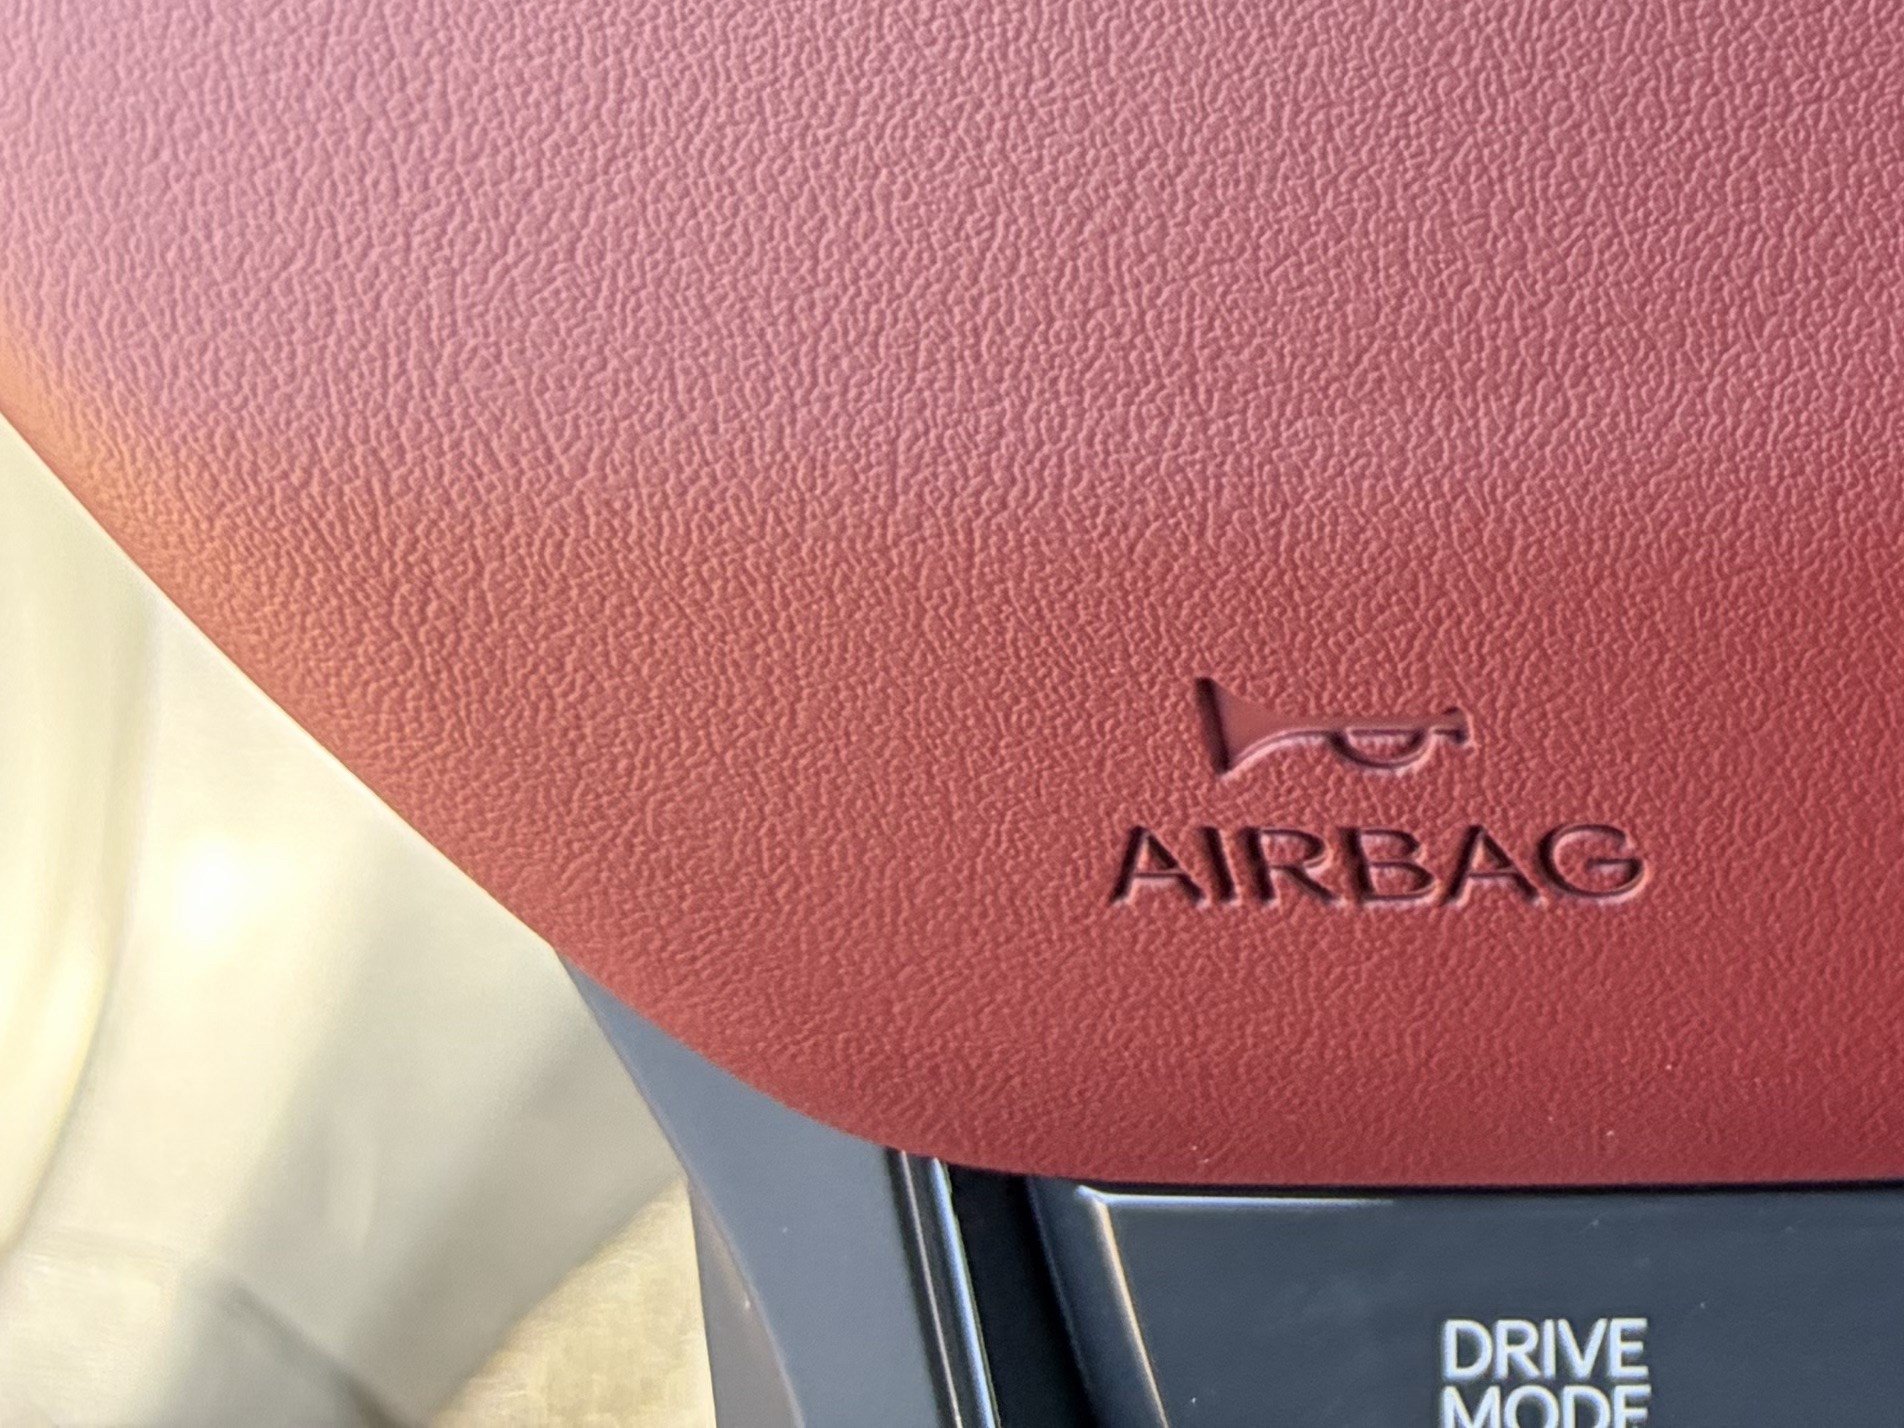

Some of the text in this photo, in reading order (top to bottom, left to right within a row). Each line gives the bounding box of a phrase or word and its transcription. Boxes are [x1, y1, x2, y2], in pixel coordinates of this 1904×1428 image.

[1107, 822, 1651, 908] AIRBAG
[1441, 1317, 1650, 1382] DRIVE
[1440, 1384, 1652, 1428] MODE
